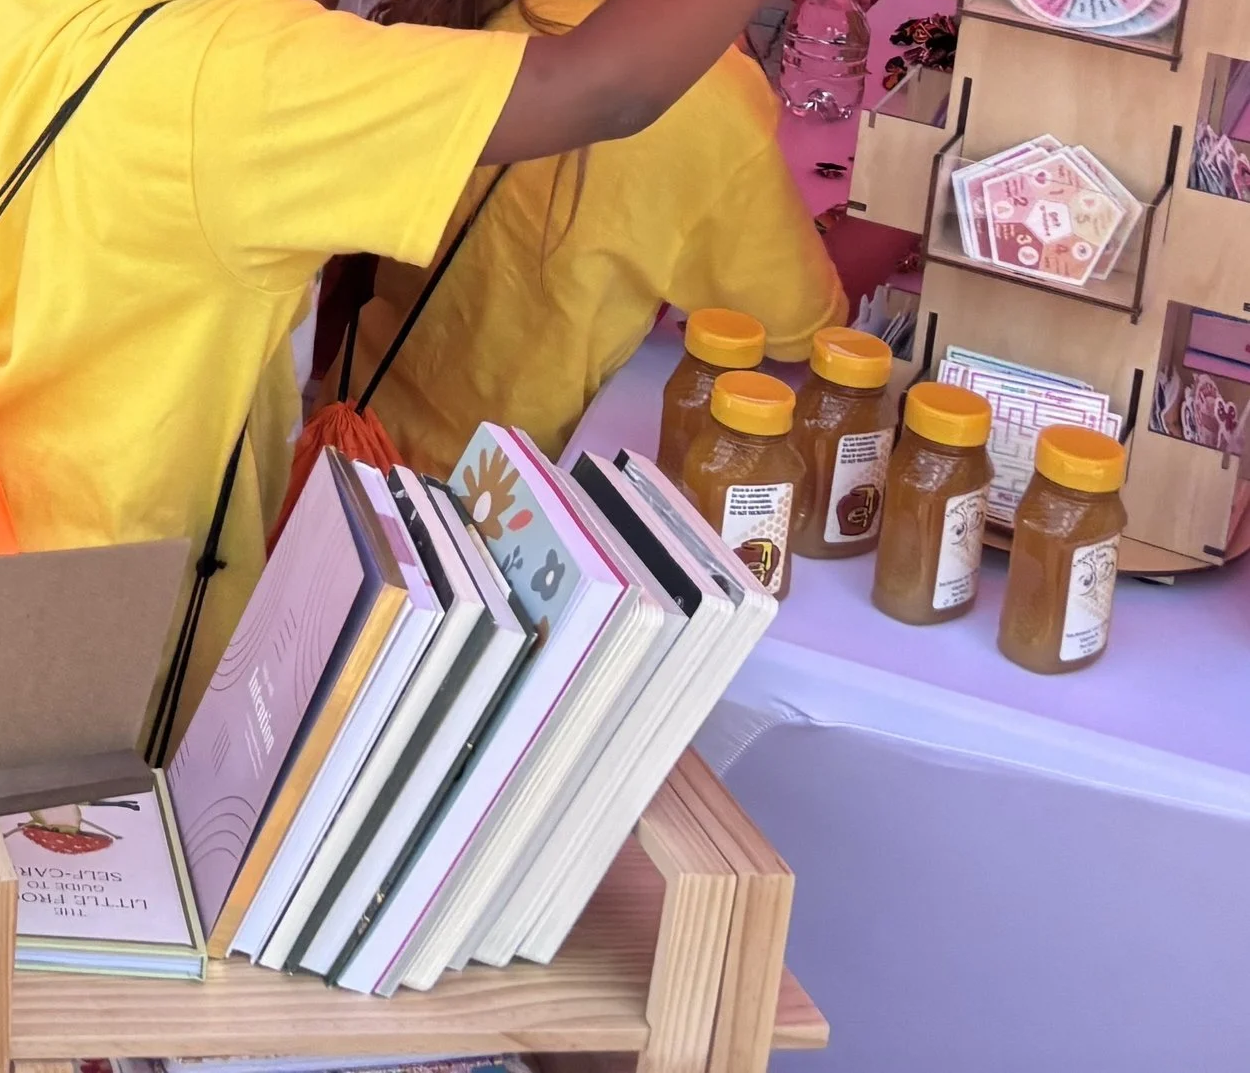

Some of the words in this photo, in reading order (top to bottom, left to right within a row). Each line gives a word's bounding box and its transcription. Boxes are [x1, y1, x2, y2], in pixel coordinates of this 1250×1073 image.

[27, 880, 50, 890] TO
[54, 882, 105, 893] GUIDE
[17, 891, 66, 905] FRO
[74, 894, 149, 910] LITTLE
[53, 907, 87, 917] THE
